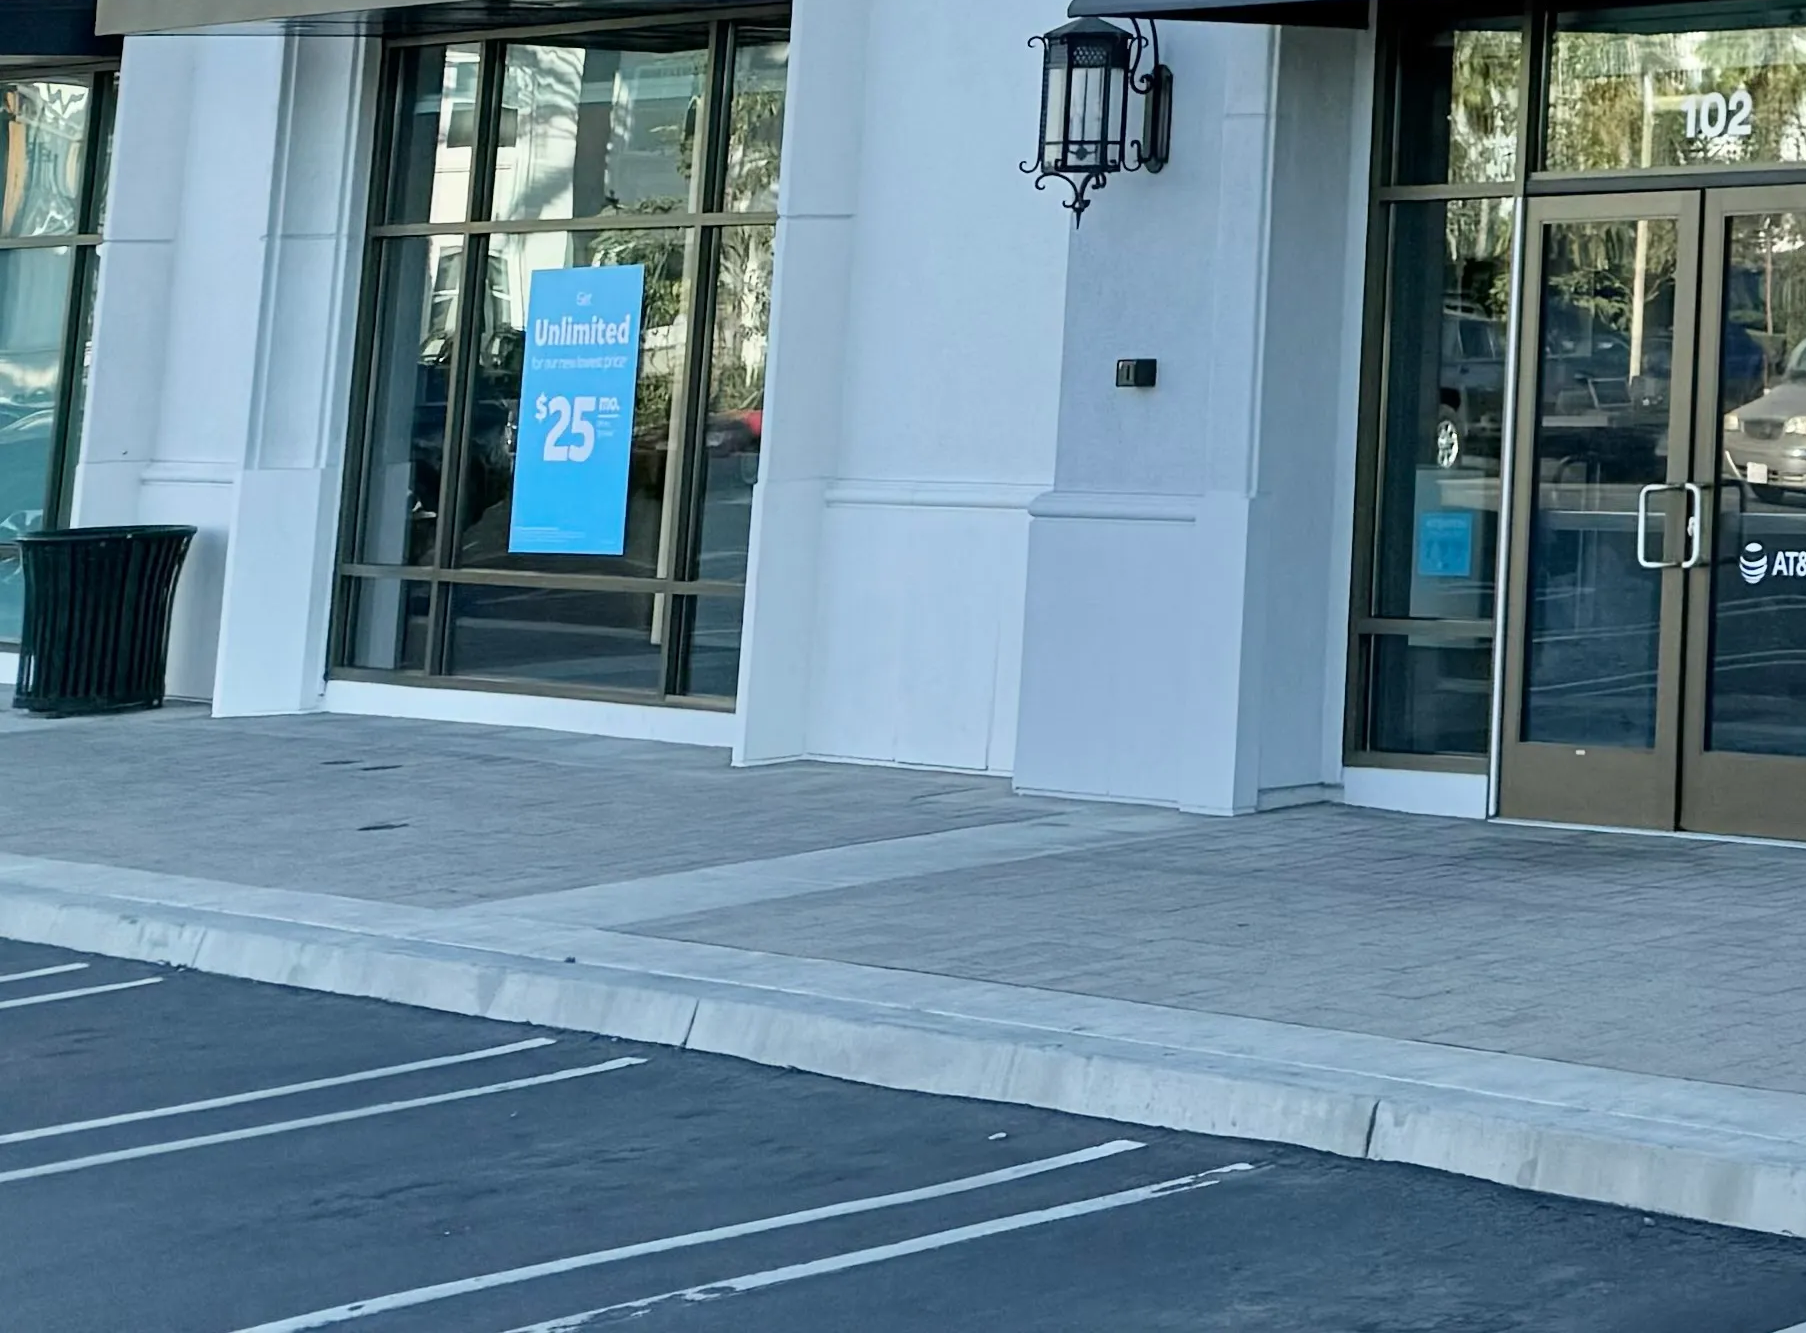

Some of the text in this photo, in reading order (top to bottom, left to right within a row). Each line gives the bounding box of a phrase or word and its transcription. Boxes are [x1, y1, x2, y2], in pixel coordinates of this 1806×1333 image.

[1680, 90, 1752, 138] 102
[535, 314, 631, 346] Unlimited
[599, 396, 621, 412] mo.
